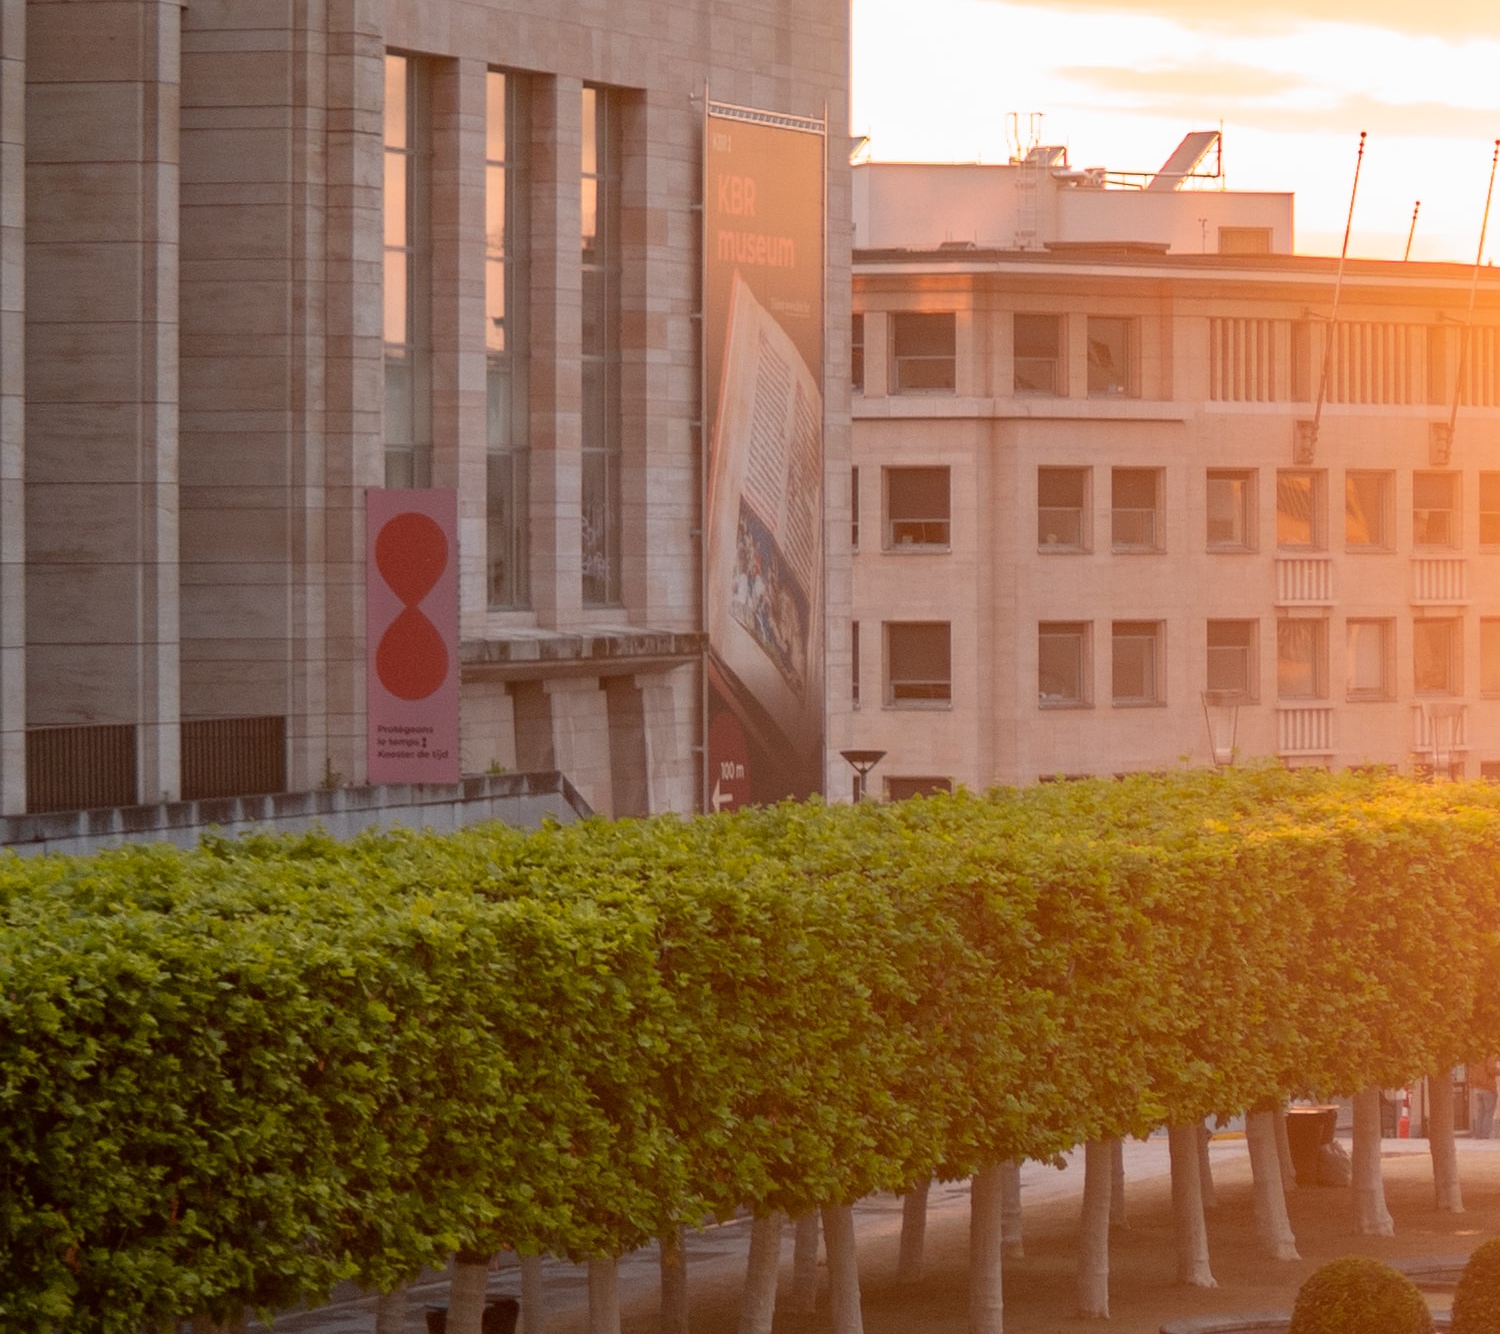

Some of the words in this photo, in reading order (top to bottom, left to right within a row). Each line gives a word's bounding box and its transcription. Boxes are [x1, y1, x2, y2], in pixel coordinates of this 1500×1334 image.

[717, 174, 756, 217] KBR
[717, 230, 796, 268] museum
[432, 749, 449, 760] tijd
[721, 761, 735, 780] 100
[736, 764, 745, 779] m
